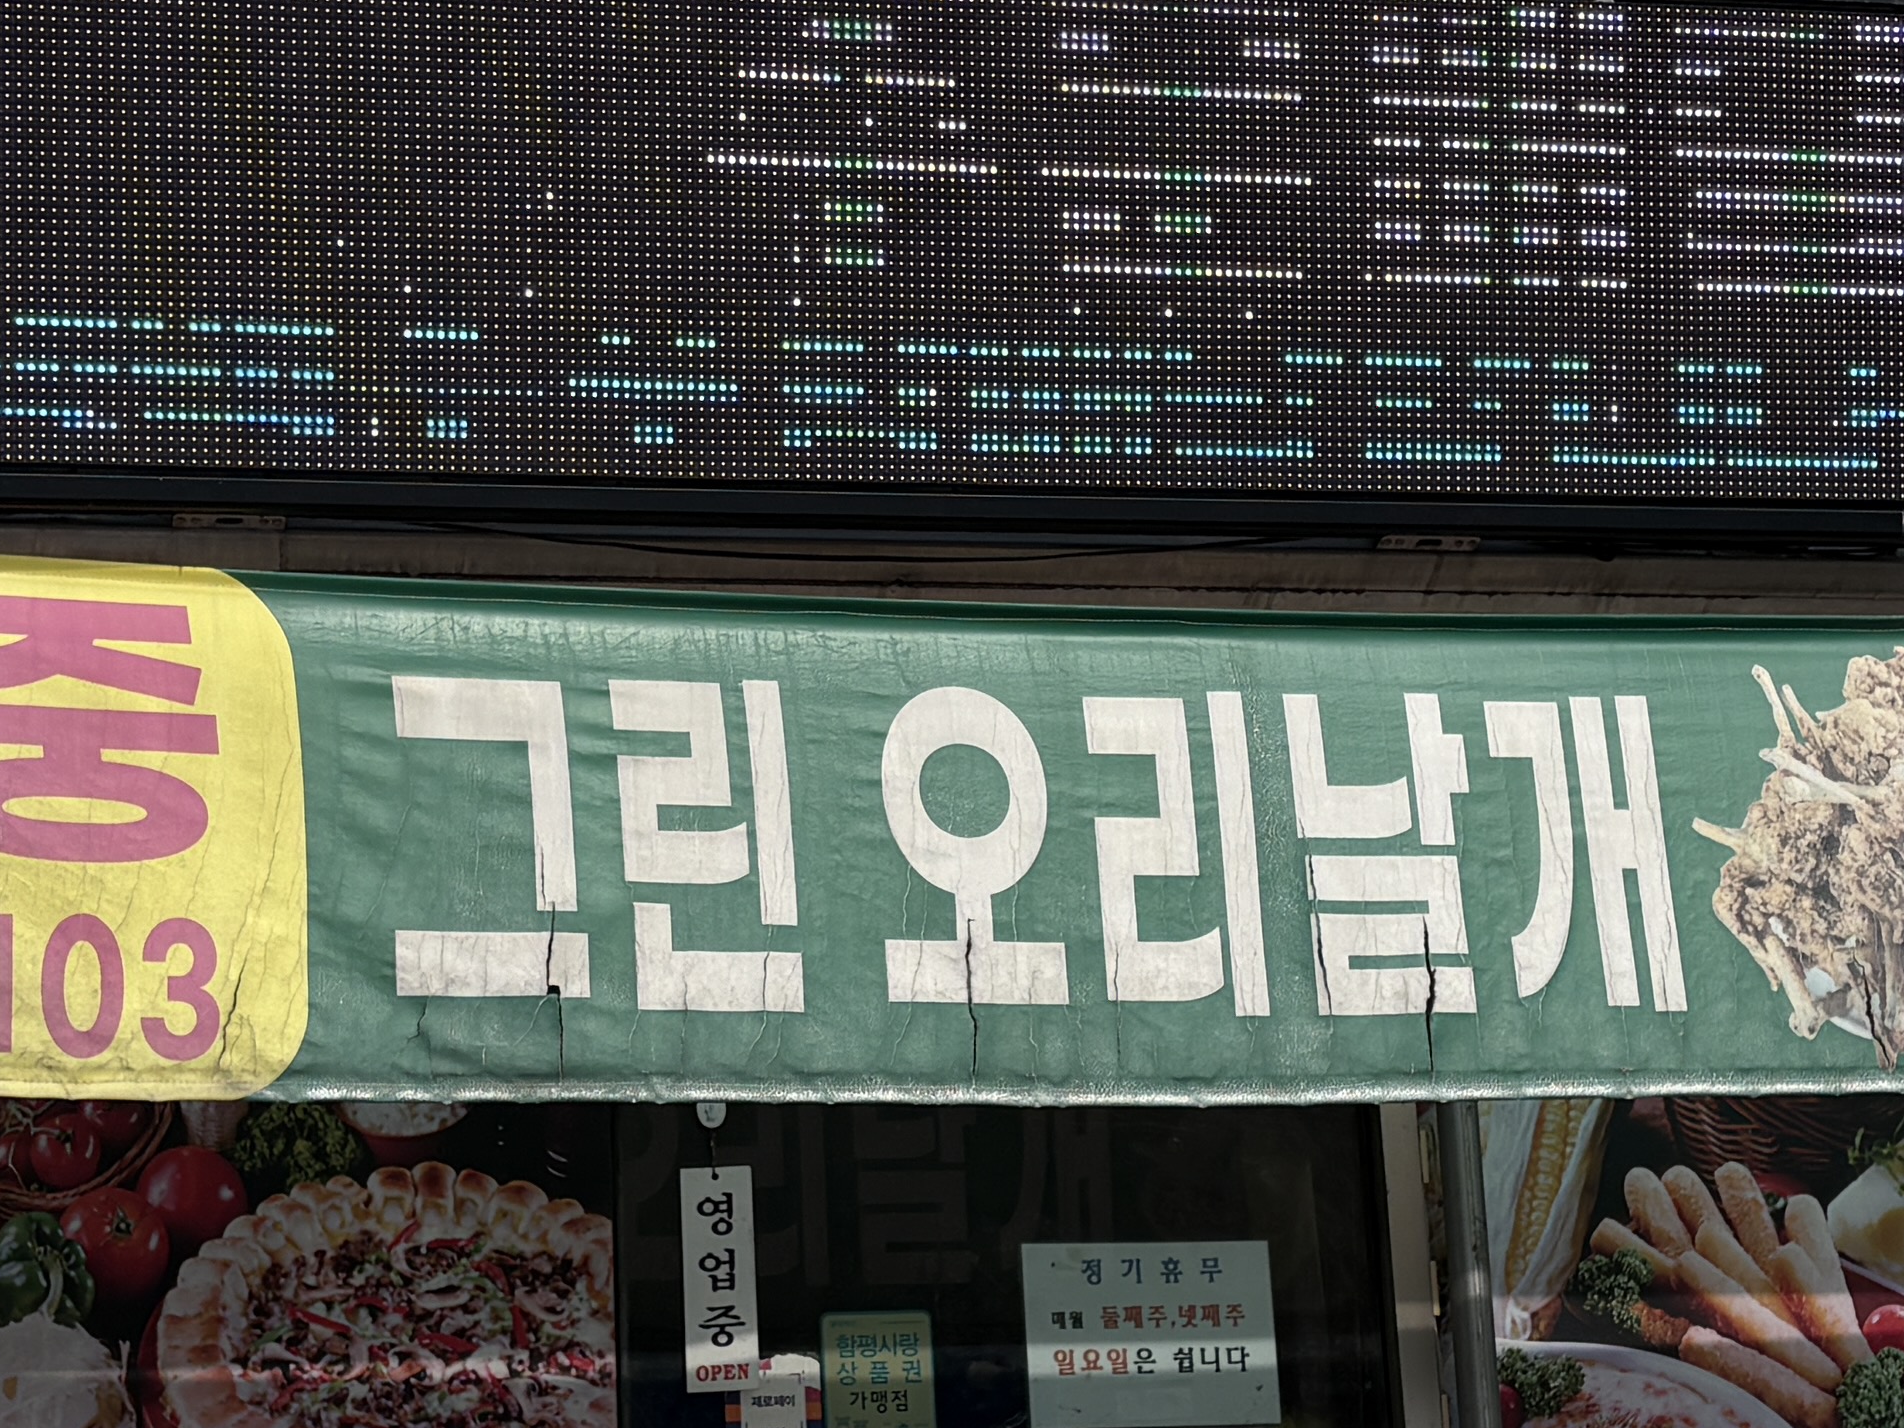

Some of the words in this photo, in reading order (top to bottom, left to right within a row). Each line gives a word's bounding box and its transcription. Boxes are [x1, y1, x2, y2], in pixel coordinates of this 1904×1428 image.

[392, 675, 805, 1013] 그린
[881, 684, 1688, 1018] 오리날개
[696, 1191, 746, 1348] 영업중
[1051, 1311, 1084, 1329] 매월
[836, 1332, 919, 1358] 함평사랑
[696, 1363, 749, 1382] OPEN
[1053, 1347, 1157, 1376] 일요일은
[1173, 1346, 1250, 1373] 쉽니다
[849, 1389, 908, 1414] 가맹점
